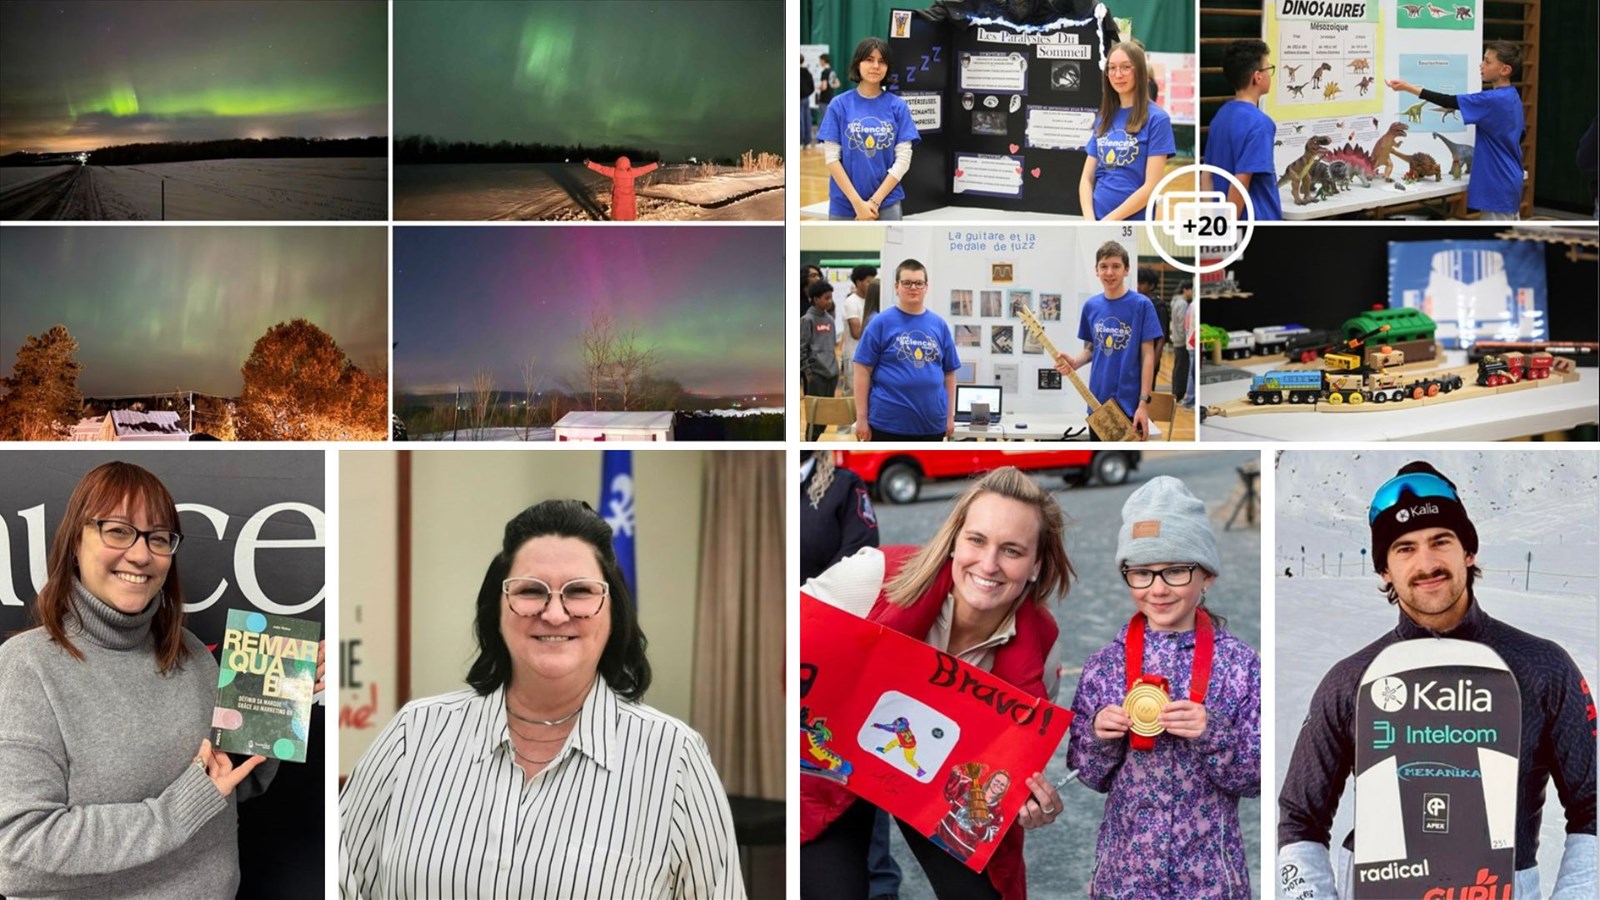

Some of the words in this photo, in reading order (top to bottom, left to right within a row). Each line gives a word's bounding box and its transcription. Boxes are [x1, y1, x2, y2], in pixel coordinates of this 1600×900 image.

[1282, 0, 1366, 18] DINOSAURES
[979, 27, 997, 40] Les
[1058, 31, 1075, 44] Du
[1039, 46, 1088, 59] Sommeil
[948, 231, 961, 241] La
[965, 232, 1005, 242] guitare
[1009, 233, 1021, 242] et
[1121, 225, 1133, 237] 35
[993, 242, 1007, 251] de
[1011, 242, 1035, 251] fuzz
[1410, 502, 1440, 518] Kalia
[928, 650, 1054, 736] Bravo!
[1413, 679, 1493, 713] Kalia
[1406, 725, 1498, 744] Intelcom
[1426, 823, 1445, 831] APEX
[1360, 859, 1430, 883] radical
